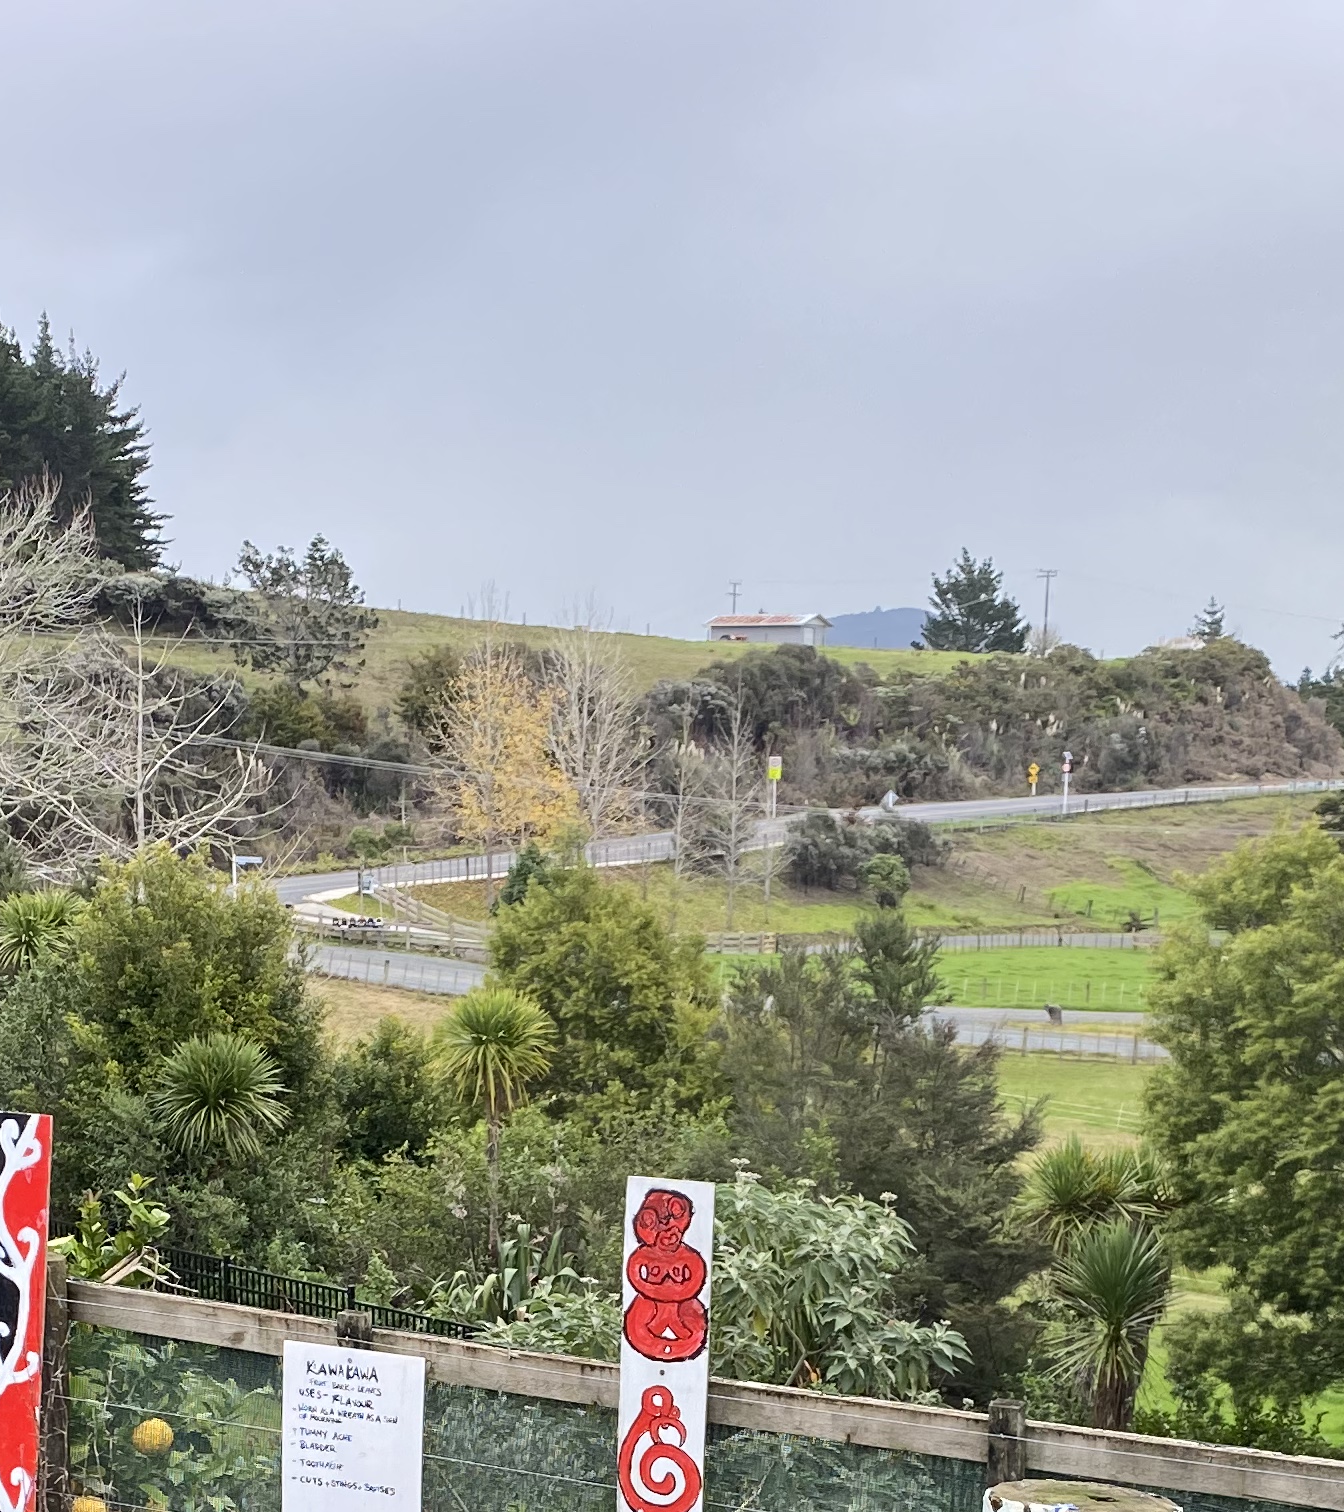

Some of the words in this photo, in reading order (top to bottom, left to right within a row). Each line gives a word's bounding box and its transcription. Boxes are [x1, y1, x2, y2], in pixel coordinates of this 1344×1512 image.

[306, 1360, 378, 1383] KAWAKAWA
[332, 1394, 374, 1410] FLAVOUR
[299, 1427, 328, 1439] TUMMY
[332, 1432, 353, 1442] ACHE
[299, 1439, 337, 1453] BLADDER
[299, 1476, 323, 1487] CUTS
